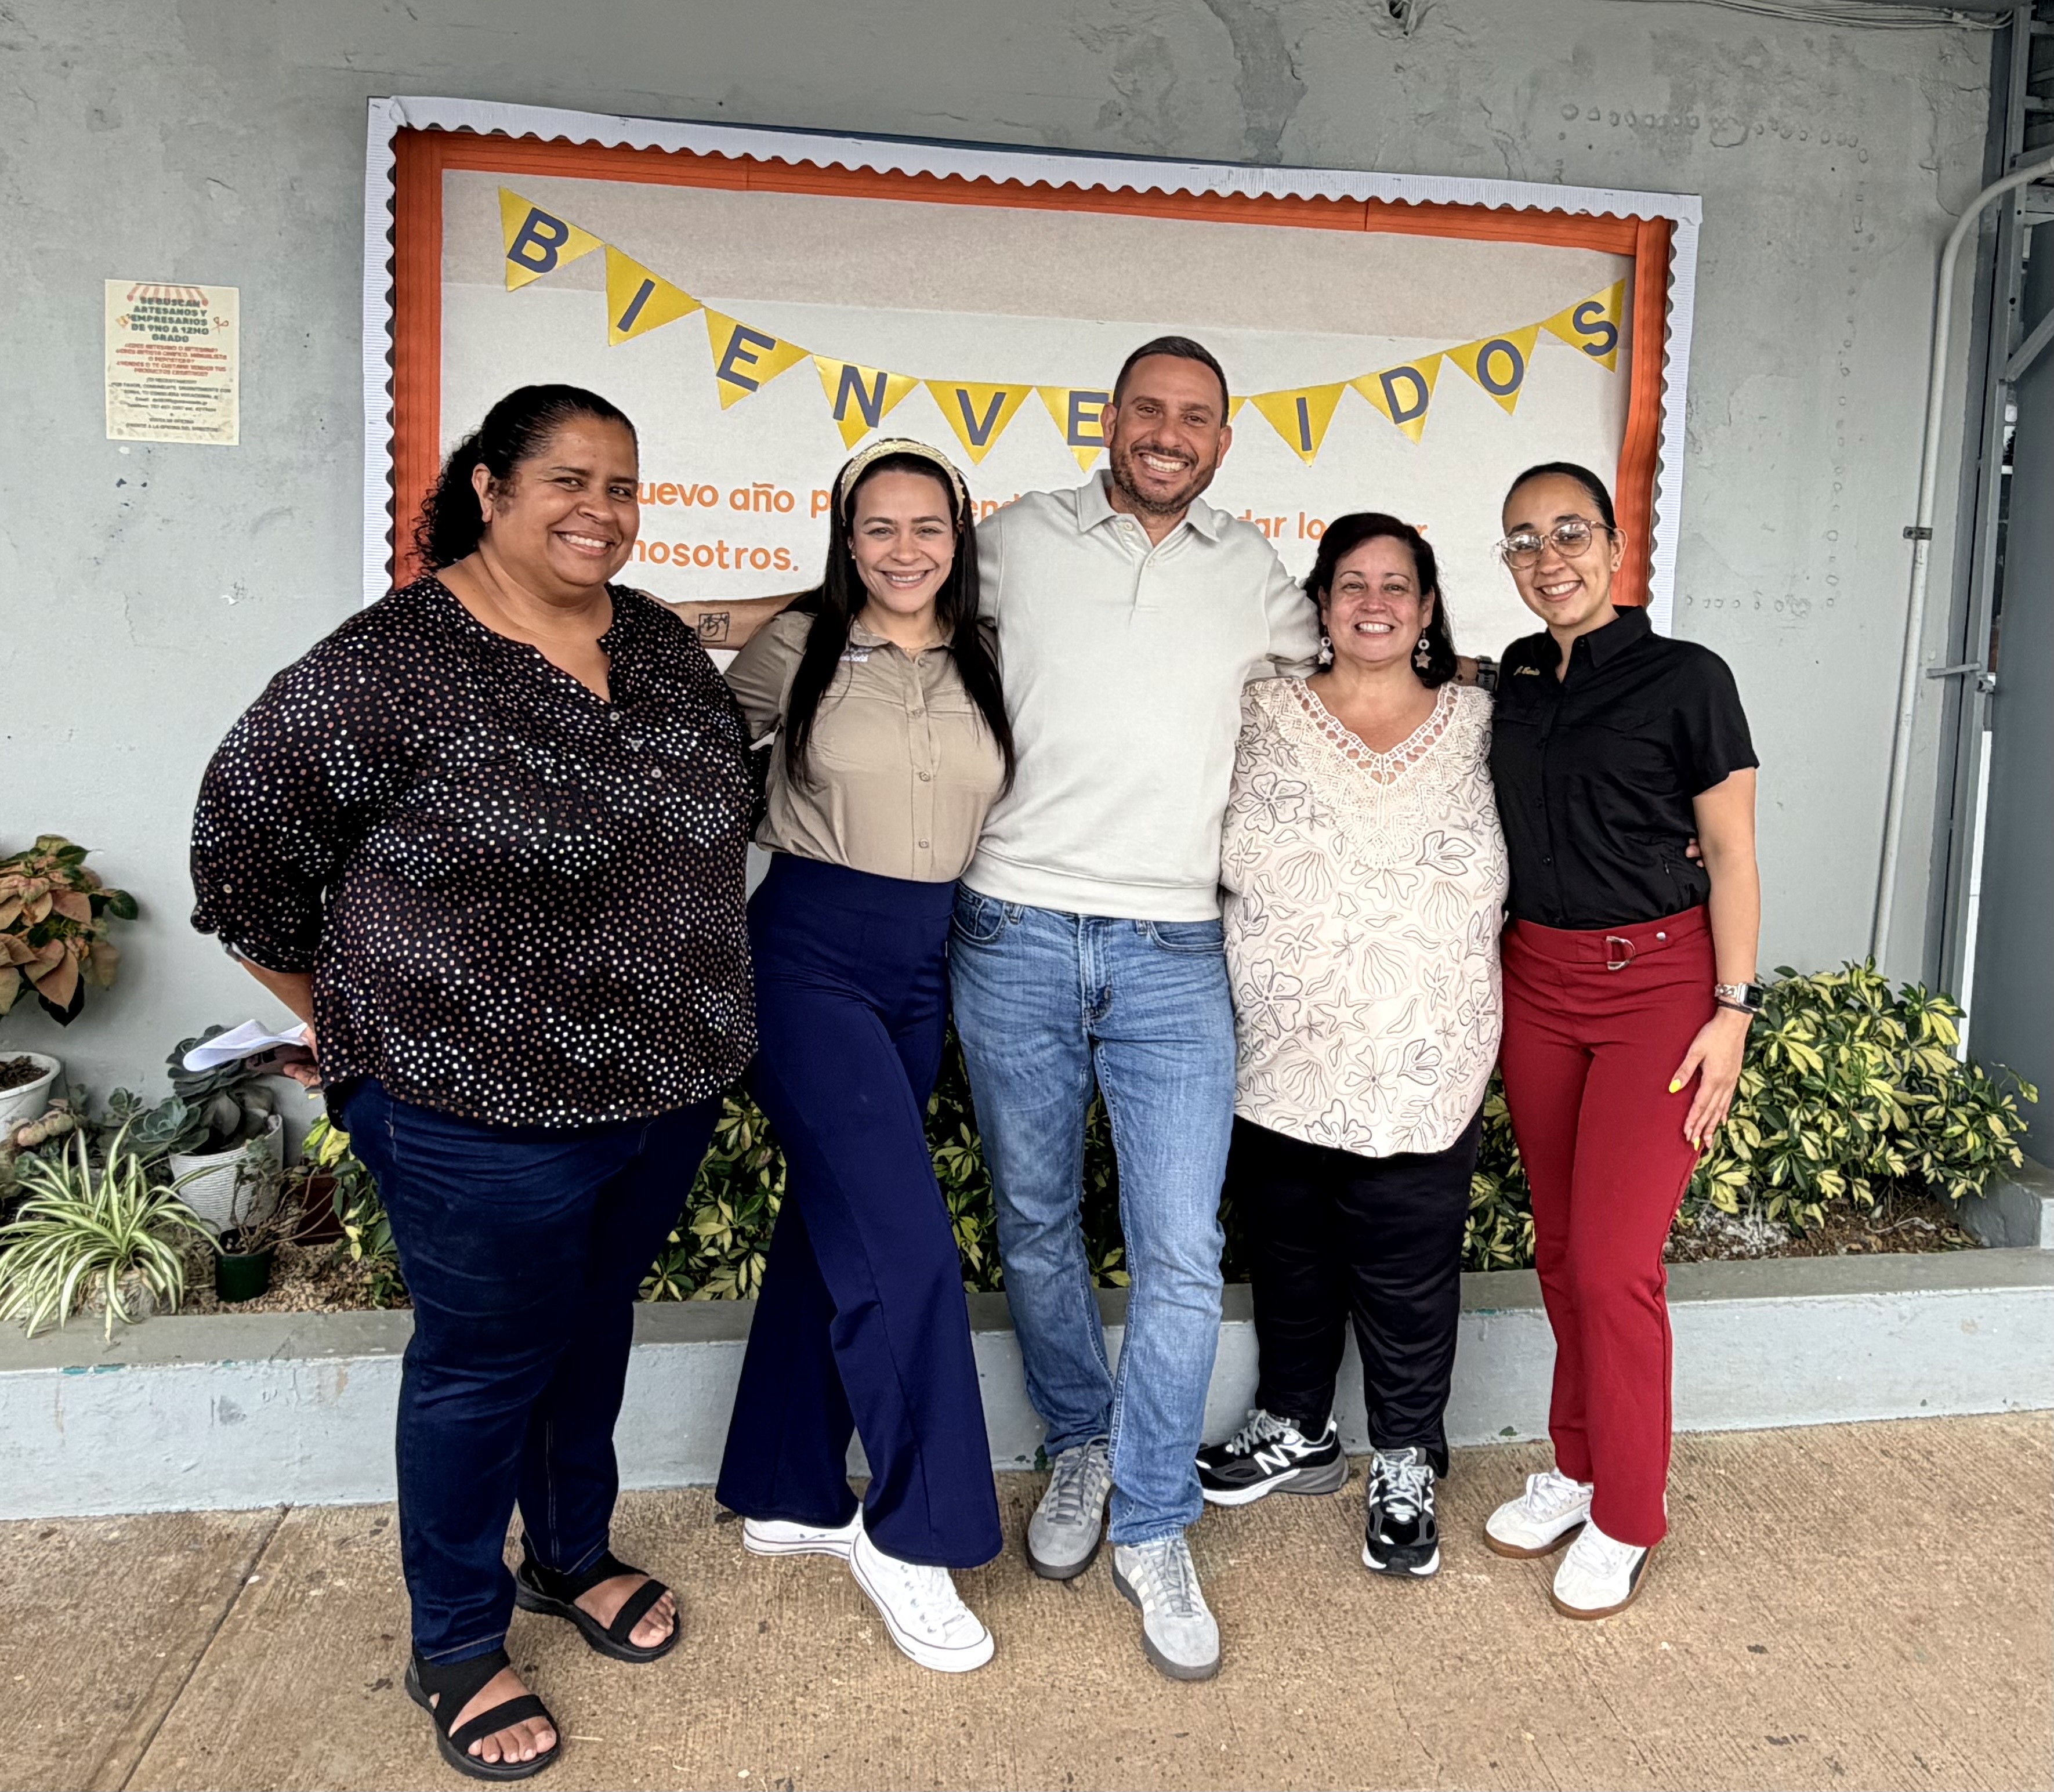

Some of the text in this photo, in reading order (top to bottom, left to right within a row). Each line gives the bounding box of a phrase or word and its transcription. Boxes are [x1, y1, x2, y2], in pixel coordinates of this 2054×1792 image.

[140, 296, 201, 308] SE BUSCAN
[133, 306, 198, 317] ARTESANOS
[131, 314, 208, 326] EMPRESARIOS
[131, 323, 145, 331] DE
[507, 207, 1618, 452] BIENVEIDOS
[152, 334, 189, 343] GRADO
[638, 482, 719, 508] uevo
[729, 482, 795, 513] año
